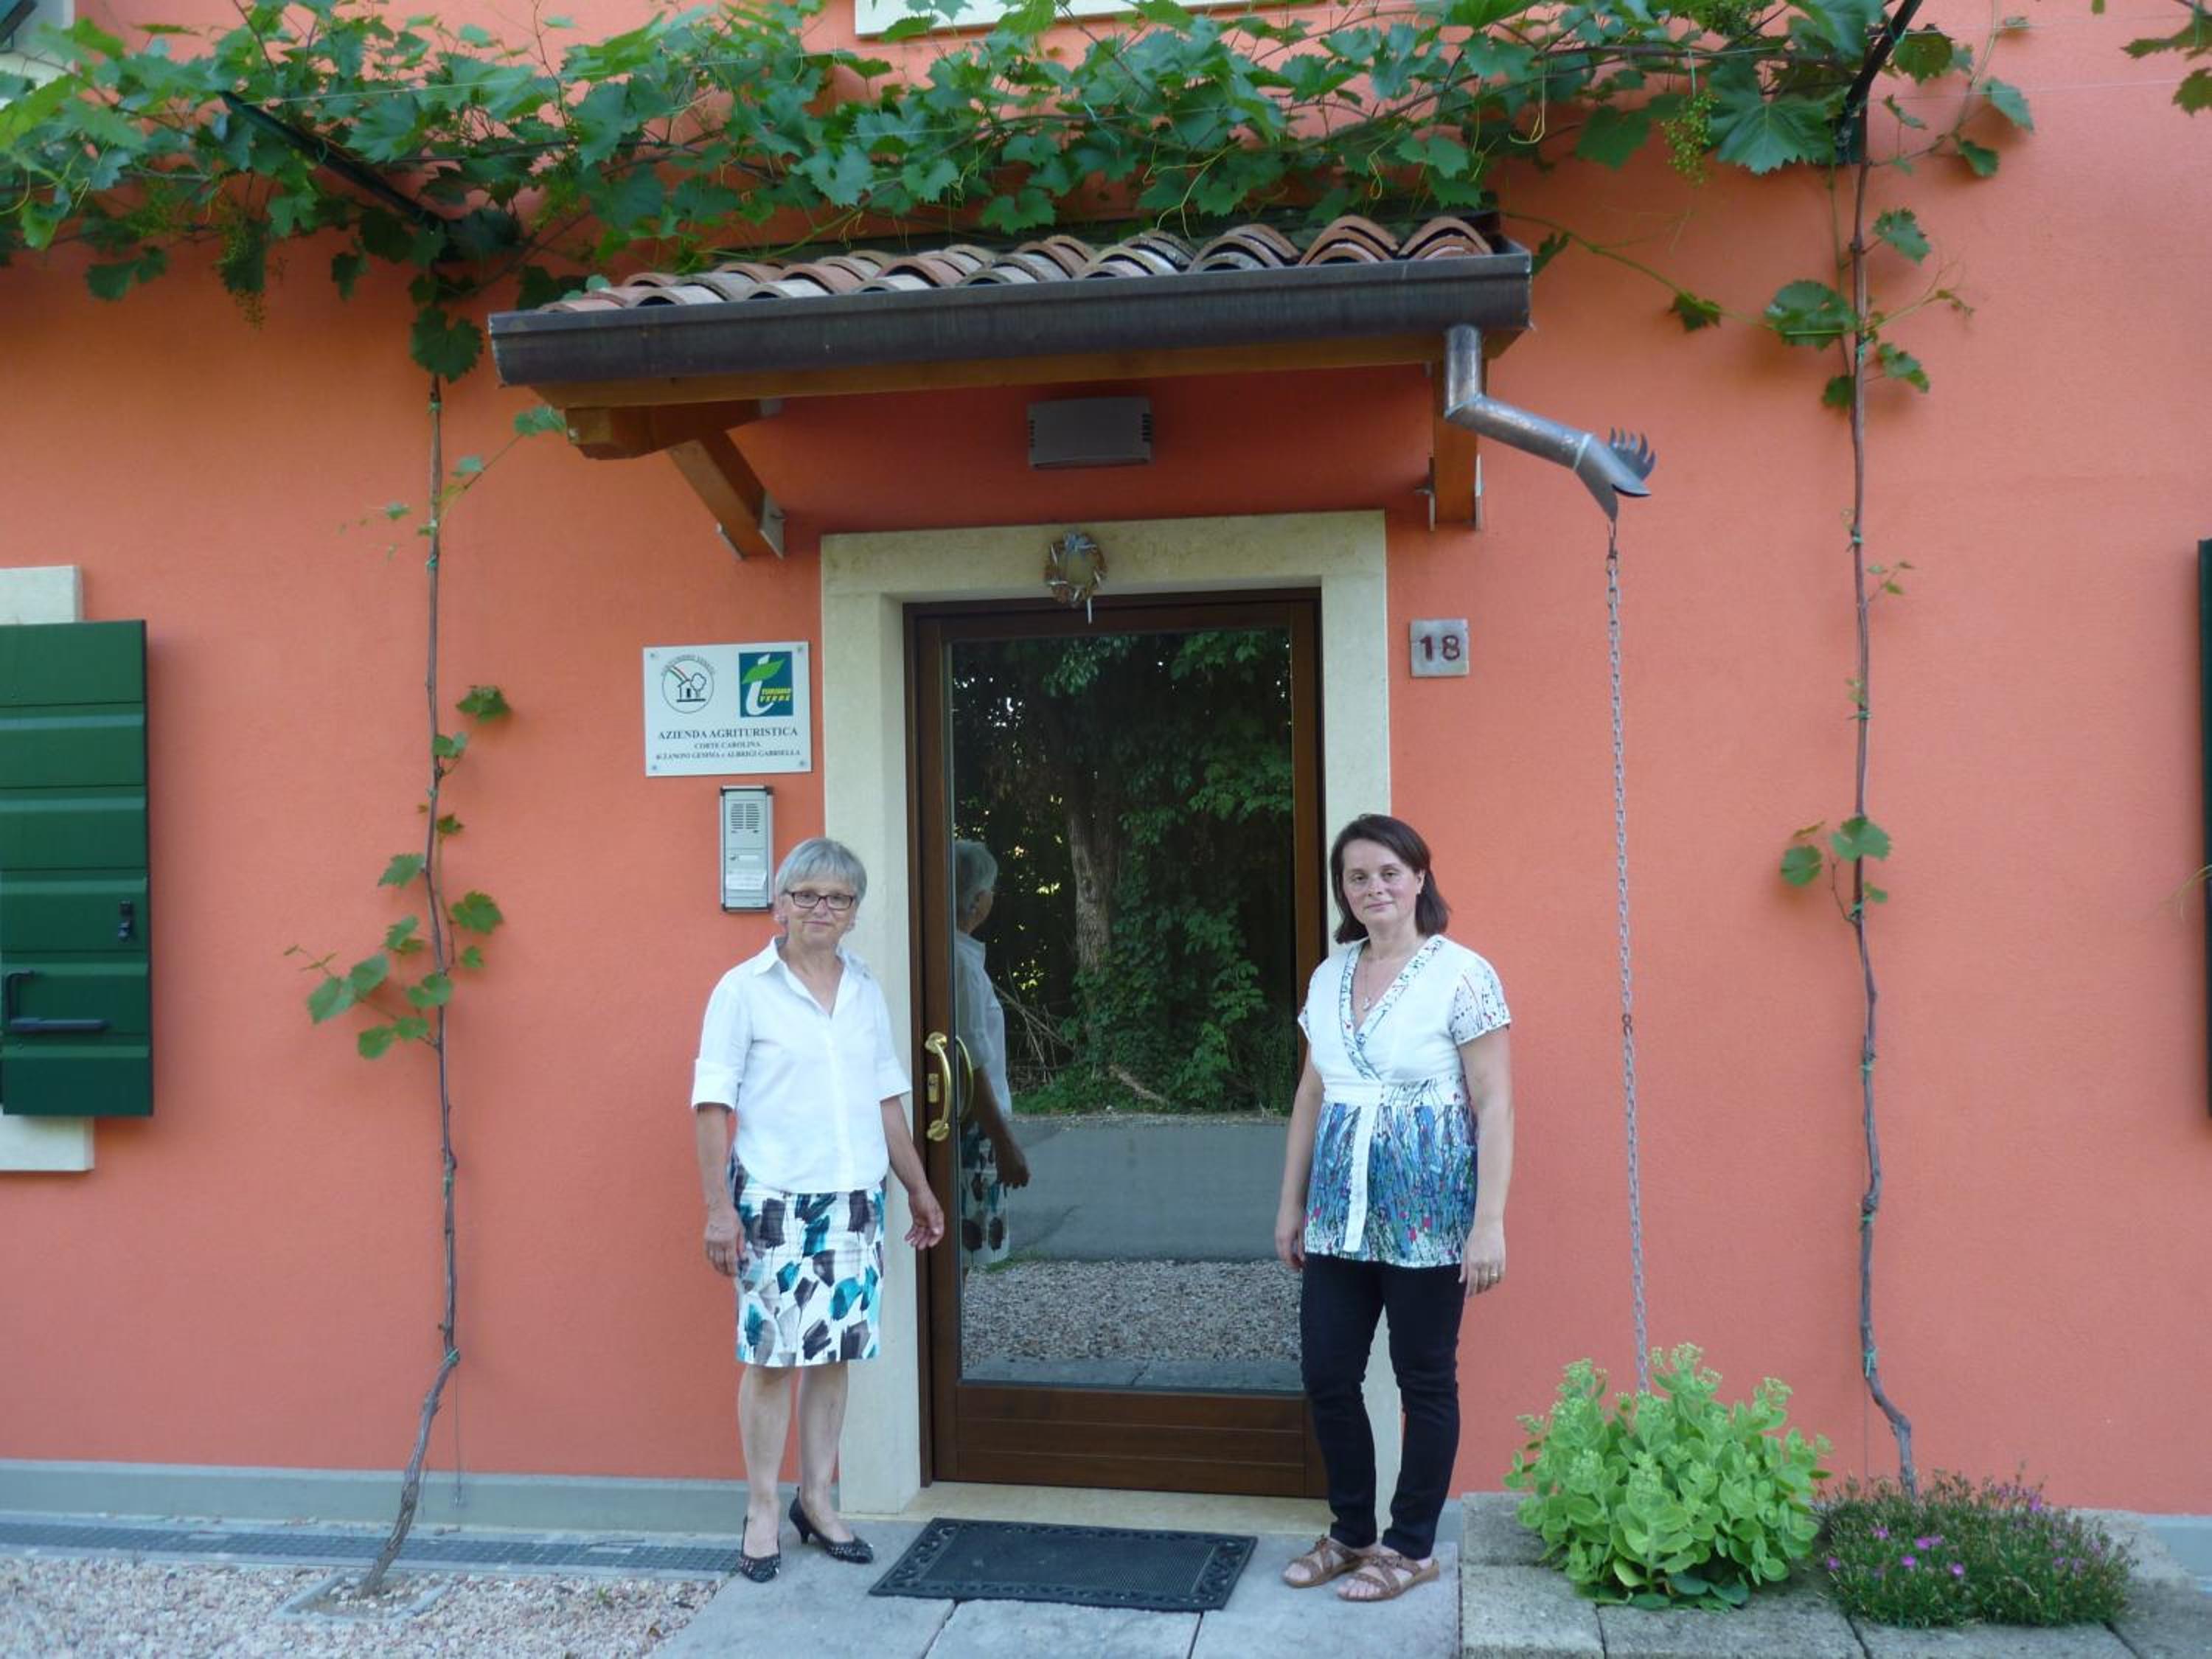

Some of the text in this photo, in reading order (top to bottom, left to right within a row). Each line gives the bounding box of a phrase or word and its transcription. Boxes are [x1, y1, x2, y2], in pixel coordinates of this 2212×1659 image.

[1419, 634, 1460, 661] 18
[659, 727, 798, 740] AZIENDA AGRITURISTICA
